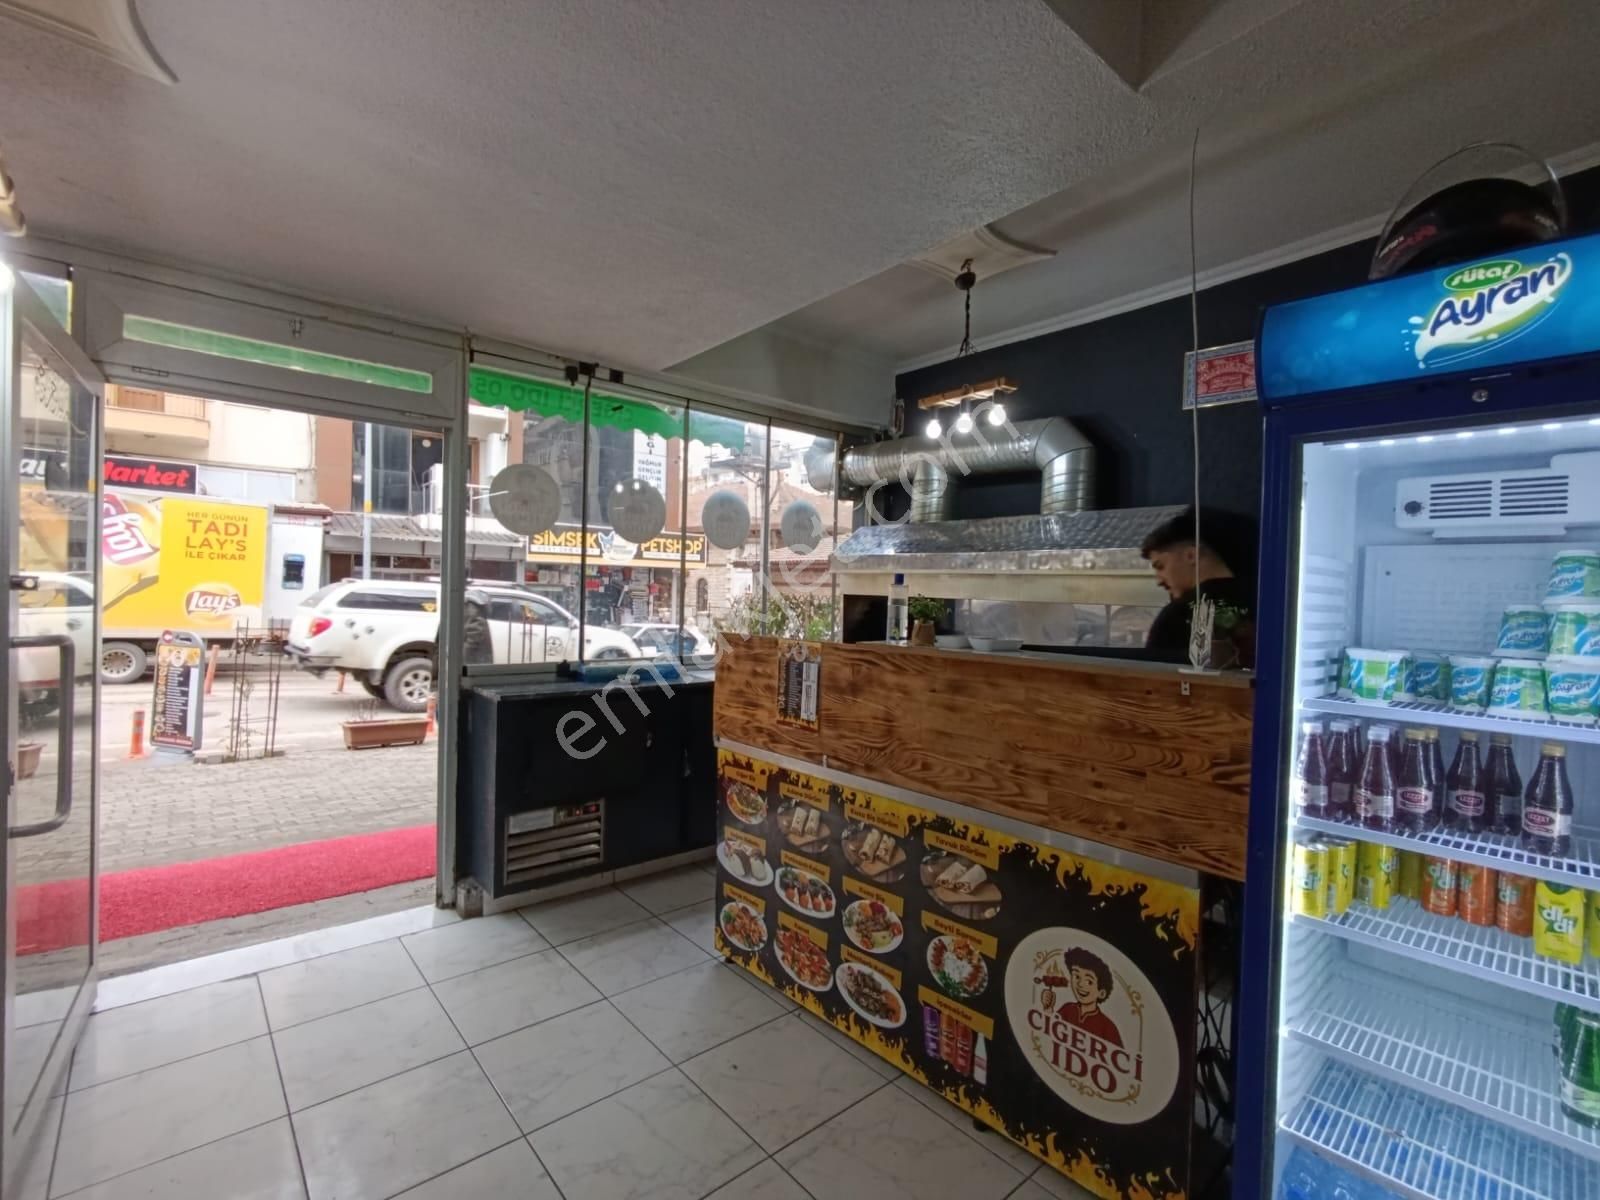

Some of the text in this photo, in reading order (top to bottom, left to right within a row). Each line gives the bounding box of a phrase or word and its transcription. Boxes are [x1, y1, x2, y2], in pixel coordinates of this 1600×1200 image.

[1430, 265, 1556, 337] Ayran
[186, 536, 247, 552] LAY'S
[188, 591, 239, 614] Lay's
